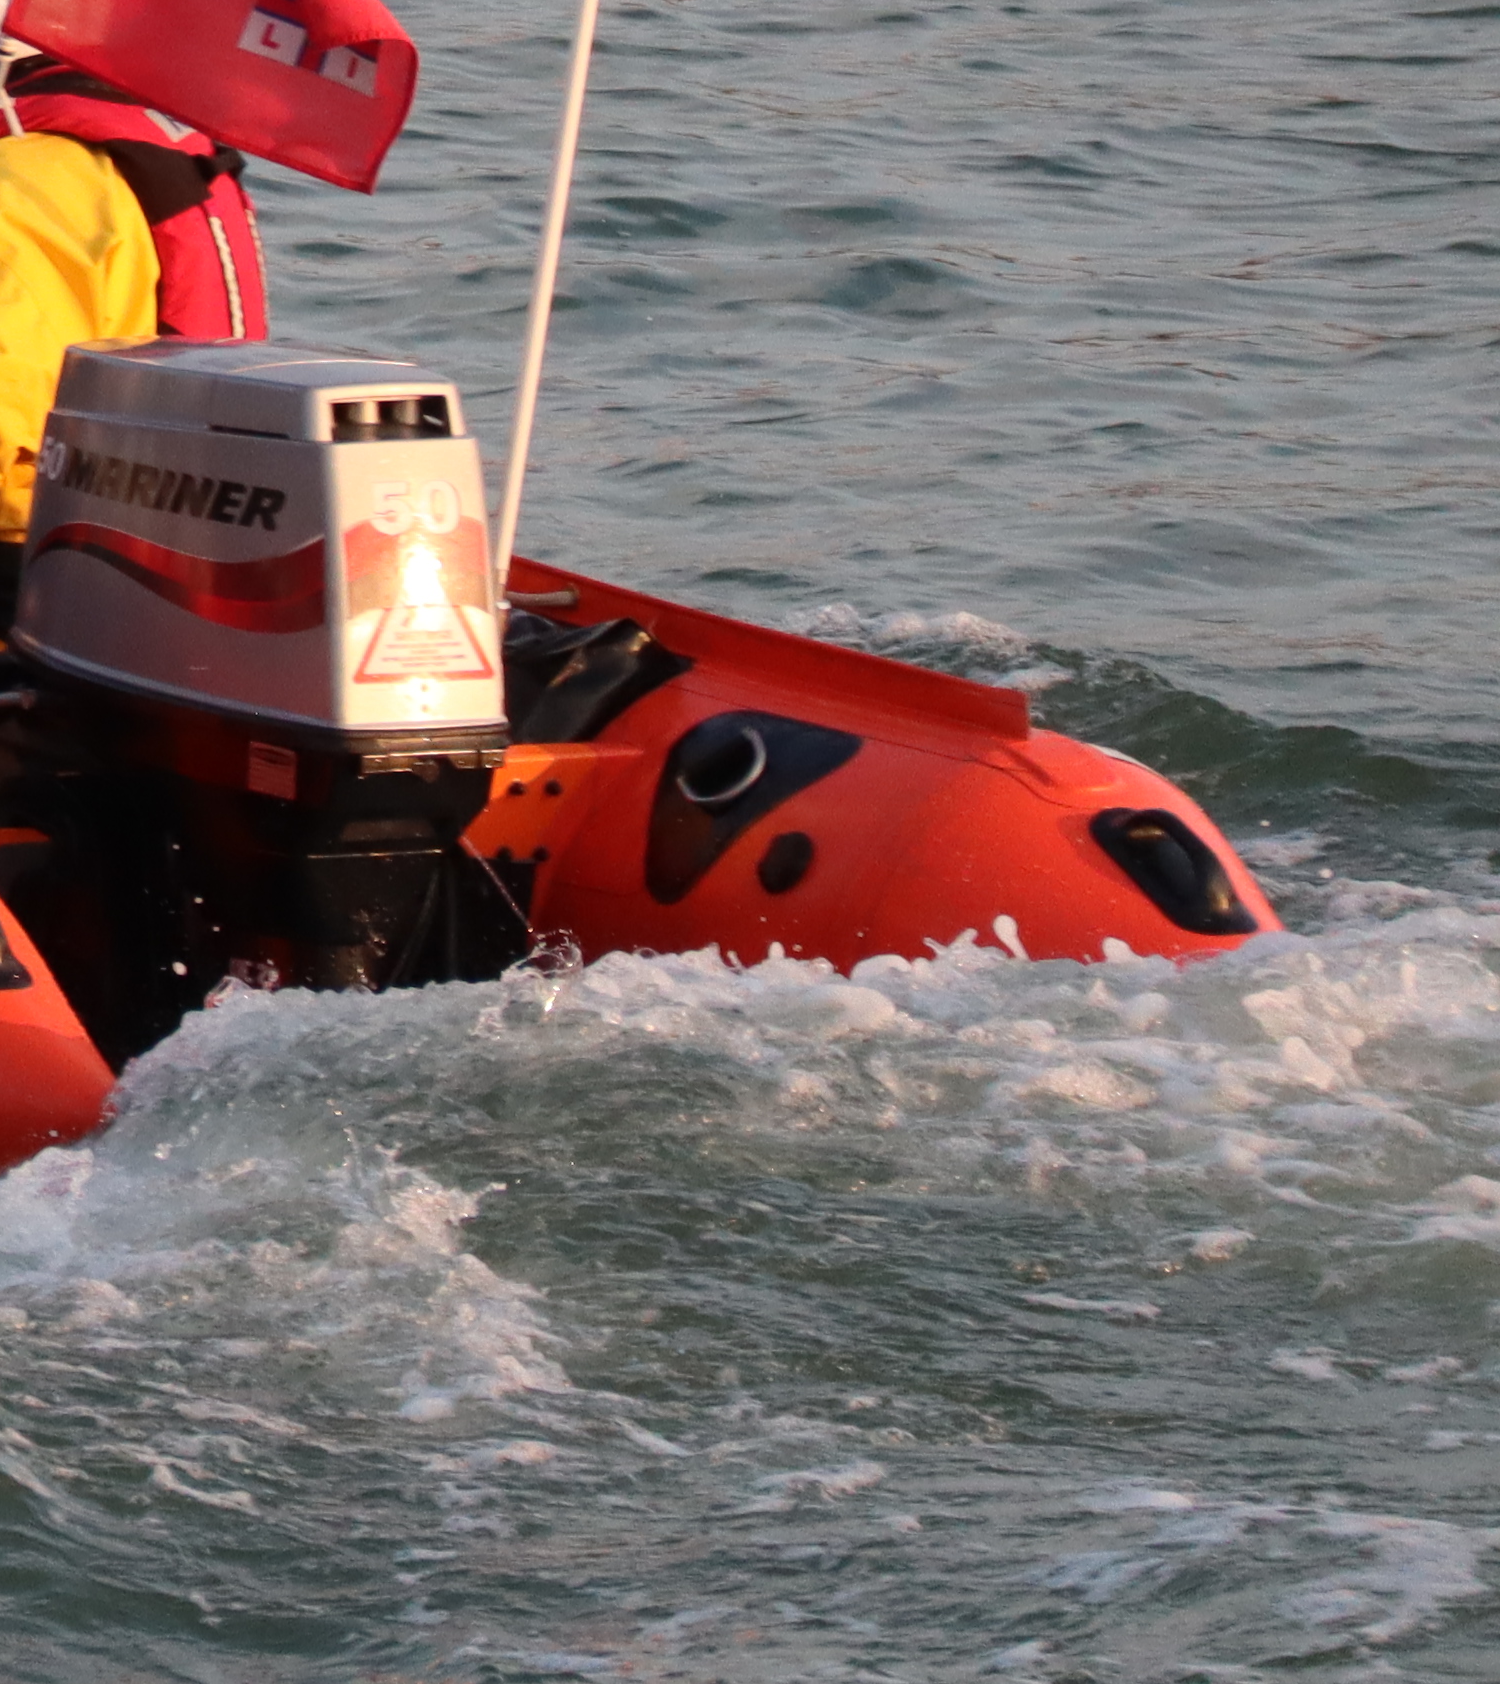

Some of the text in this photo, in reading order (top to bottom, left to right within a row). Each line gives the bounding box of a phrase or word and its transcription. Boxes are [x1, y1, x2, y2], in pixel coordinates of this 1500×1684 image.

[261, 22, 281, 50] L
[63, 446, 287, 532] MARINER
[370, 479, 461, 536] 50
